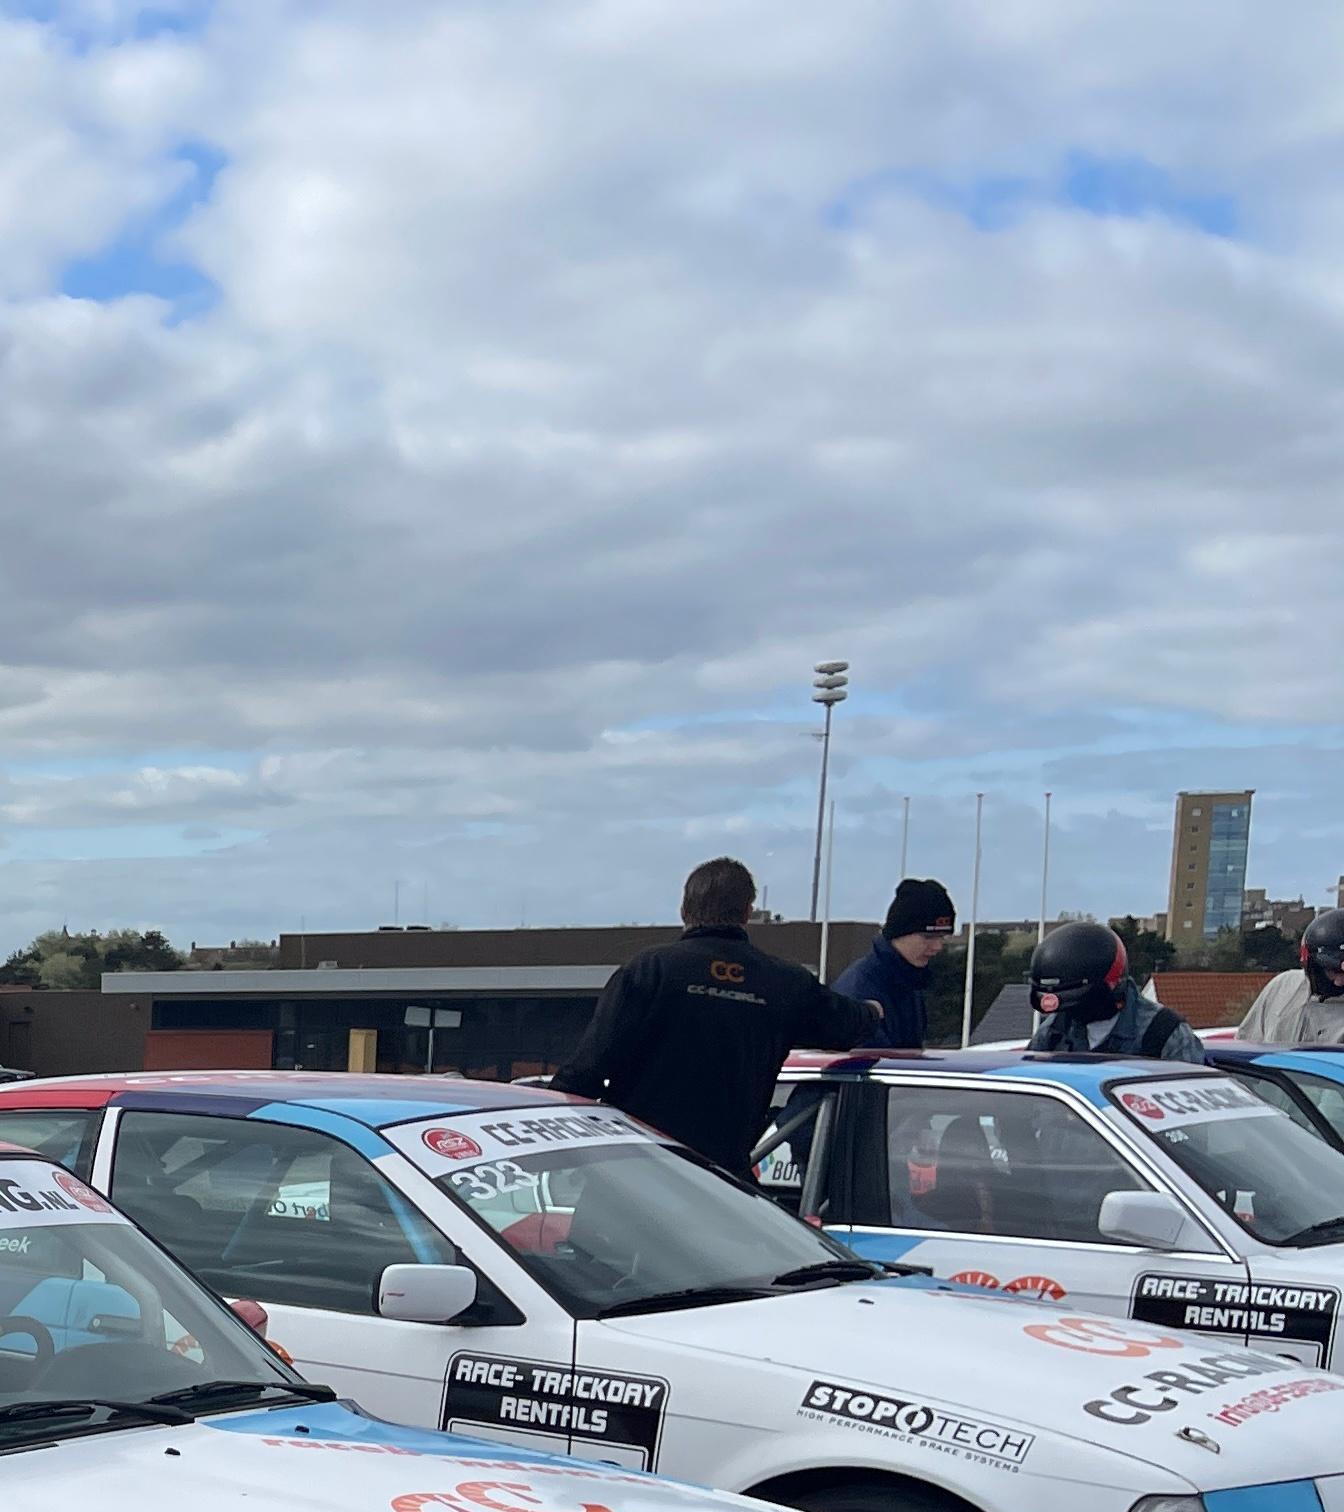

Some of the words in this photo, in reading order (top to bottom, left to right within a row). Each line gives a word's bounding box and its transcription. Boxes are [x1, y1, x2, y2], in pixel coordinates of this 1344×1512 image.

[710, 960, 745, 983] CC
[451, 1160, 538, 1200] 323
[1142, 1278, 1207, 1299] RACE-
[1214, 1282, 1333, 1311] TRACKDAY
[1184, 1305, 1286, 1333] RENTALS
[456, 1358, 523, 1389] RACE-
[531, 1368, 661, 1409] TRACKDAY
[499, 1396, 609, 1437] RENTALS
